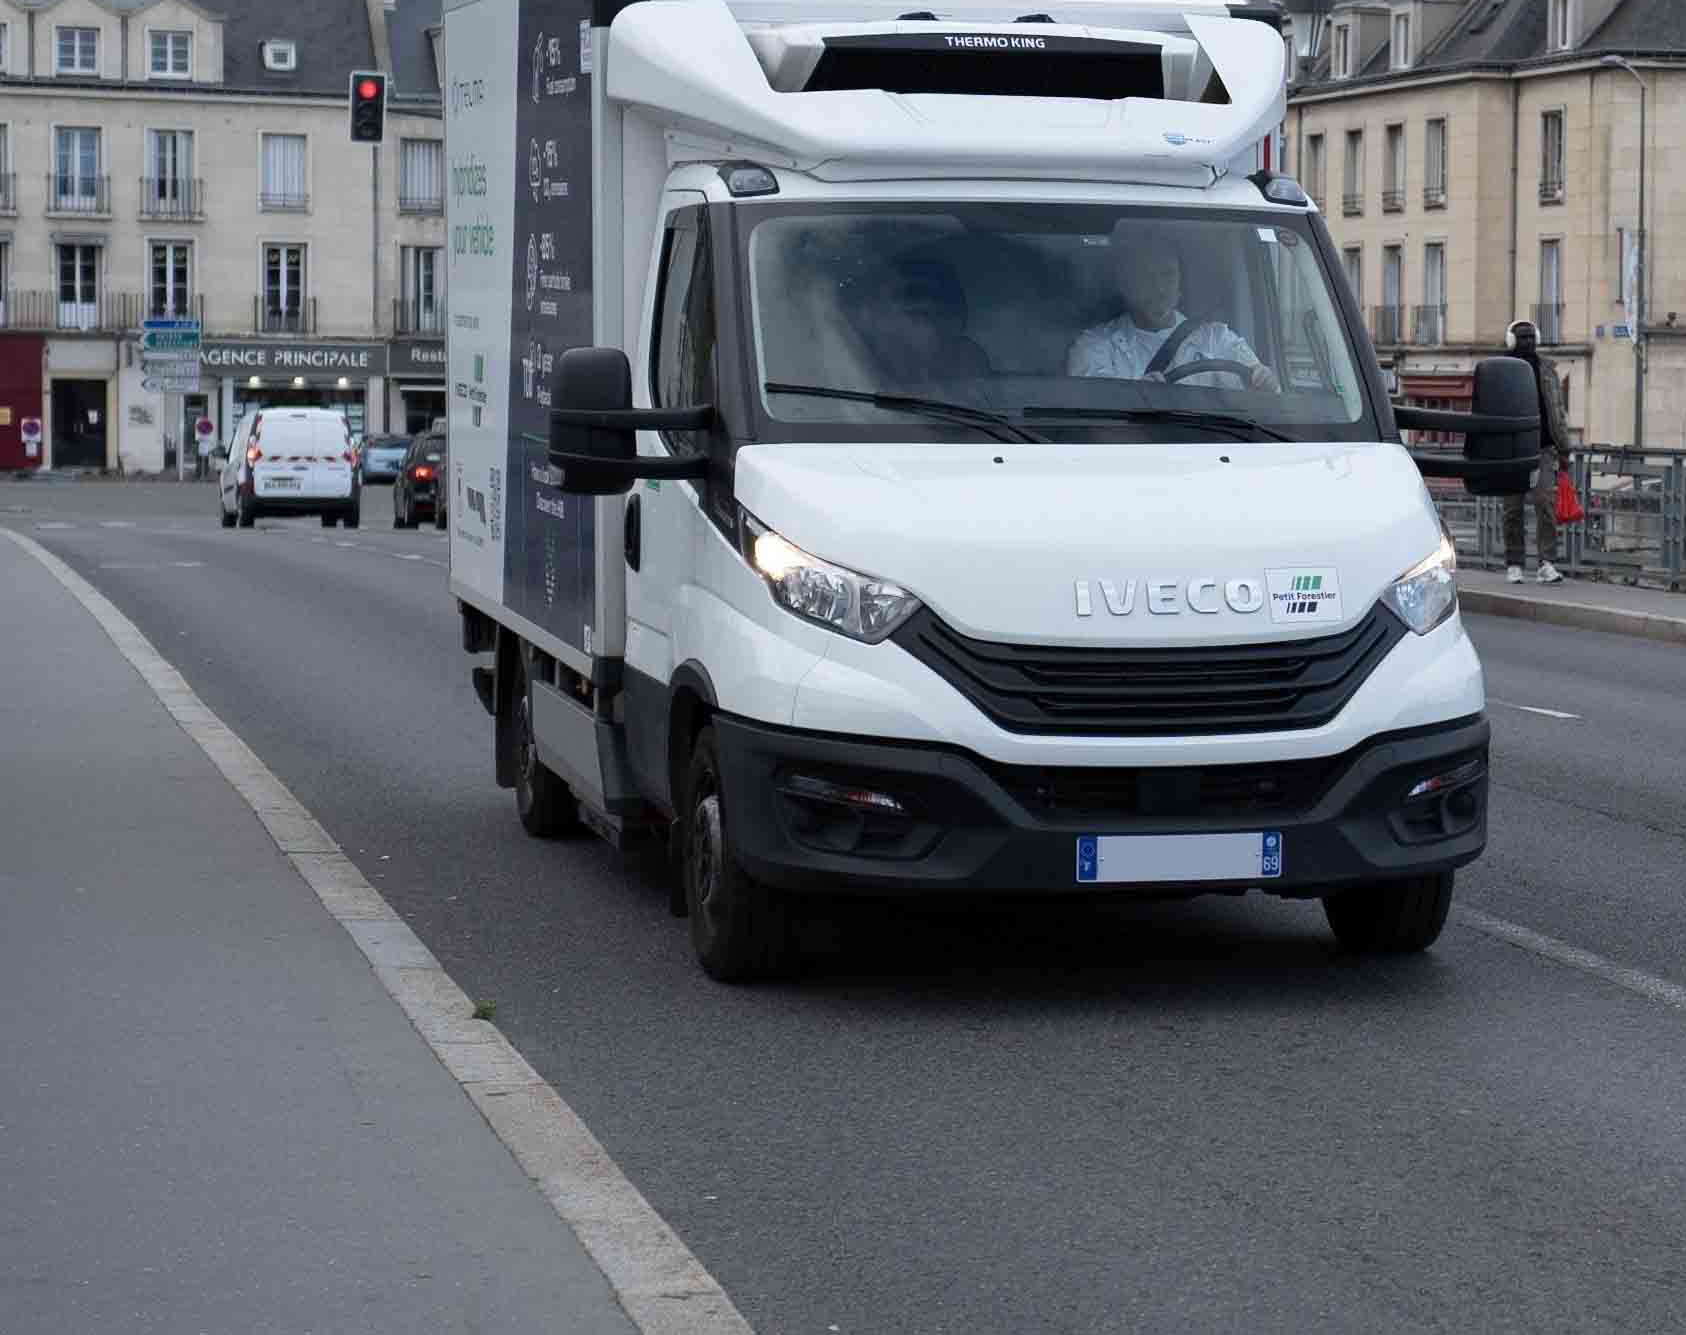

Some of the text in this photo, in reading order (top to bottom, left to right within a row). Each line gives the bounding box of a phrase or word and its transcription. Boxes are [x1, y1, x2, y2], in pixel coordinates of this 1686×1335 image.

[944, 36, 1046, 49] THERMO KING
[200, 350, 369, 368] AGENCE PRINCIPALE
[1074, 574, 1264, 617] IVECO
[1272, 591, 1337, 602] Petit Forestier
[1262, 855, 1280, 872] 69
